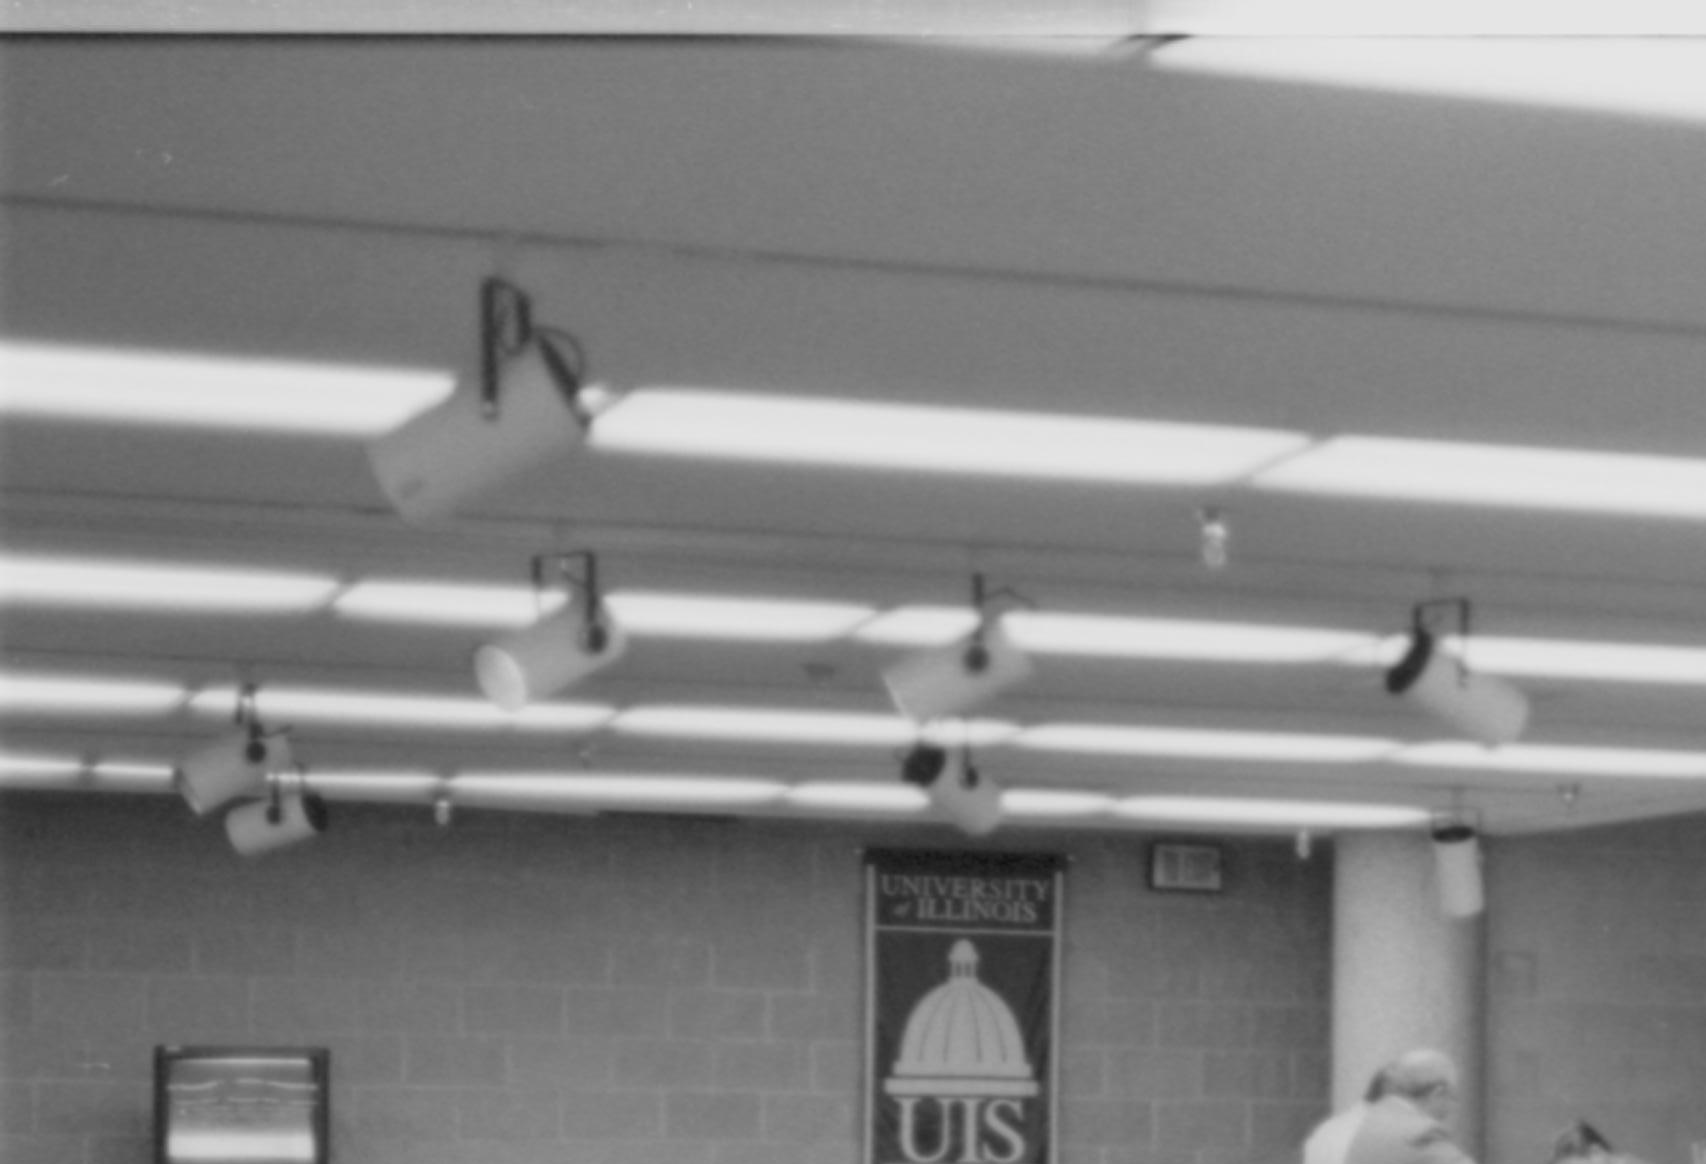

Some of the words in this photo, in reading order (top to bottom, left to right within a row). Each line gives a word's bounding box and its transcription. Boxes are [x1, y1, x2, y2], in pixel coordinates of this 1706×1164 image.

[880, 873, 1049, 902] UNIVERSITY
[917, 898, 1038, 923] ILLINOIS
[894, 1098, 1028, 1164] UIS
